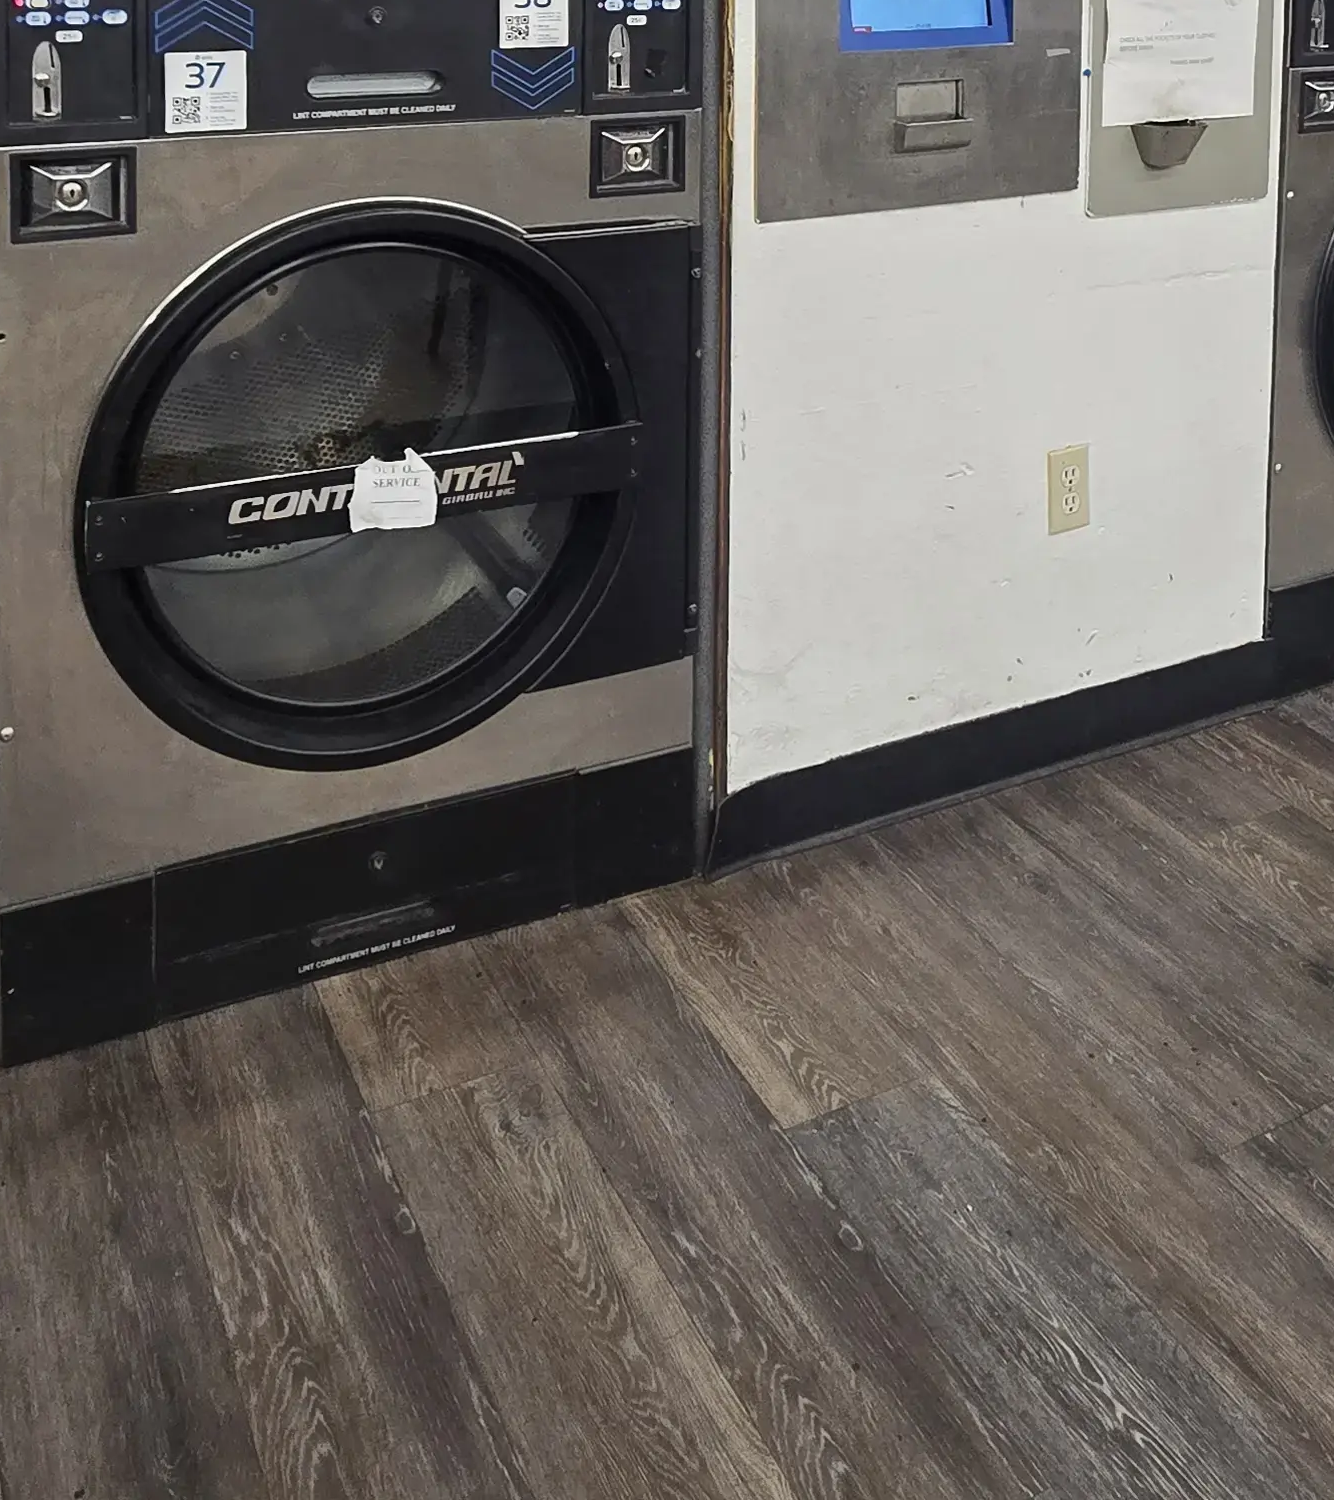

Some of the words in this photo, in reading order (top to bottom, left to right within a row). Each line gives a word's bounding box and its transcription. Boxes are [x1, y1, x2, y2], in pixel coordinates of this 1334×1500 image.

[184, 62, 226, 89] 37
[228, 451, 516, 526] CONTNTAL
[373, 477, 421, 488] SERVICE
[442, 490, 493, 505] GIRBAU
[298, 963, 315, 974] LINT
[315, 948, 369, 969] COMPARTMENT
[370, 942, 390, 954] MUST
[392, 939, 402, 948] BE
[403, 931, 435, 945] CLEANED
[437, 925, 456, 937] DAILY
